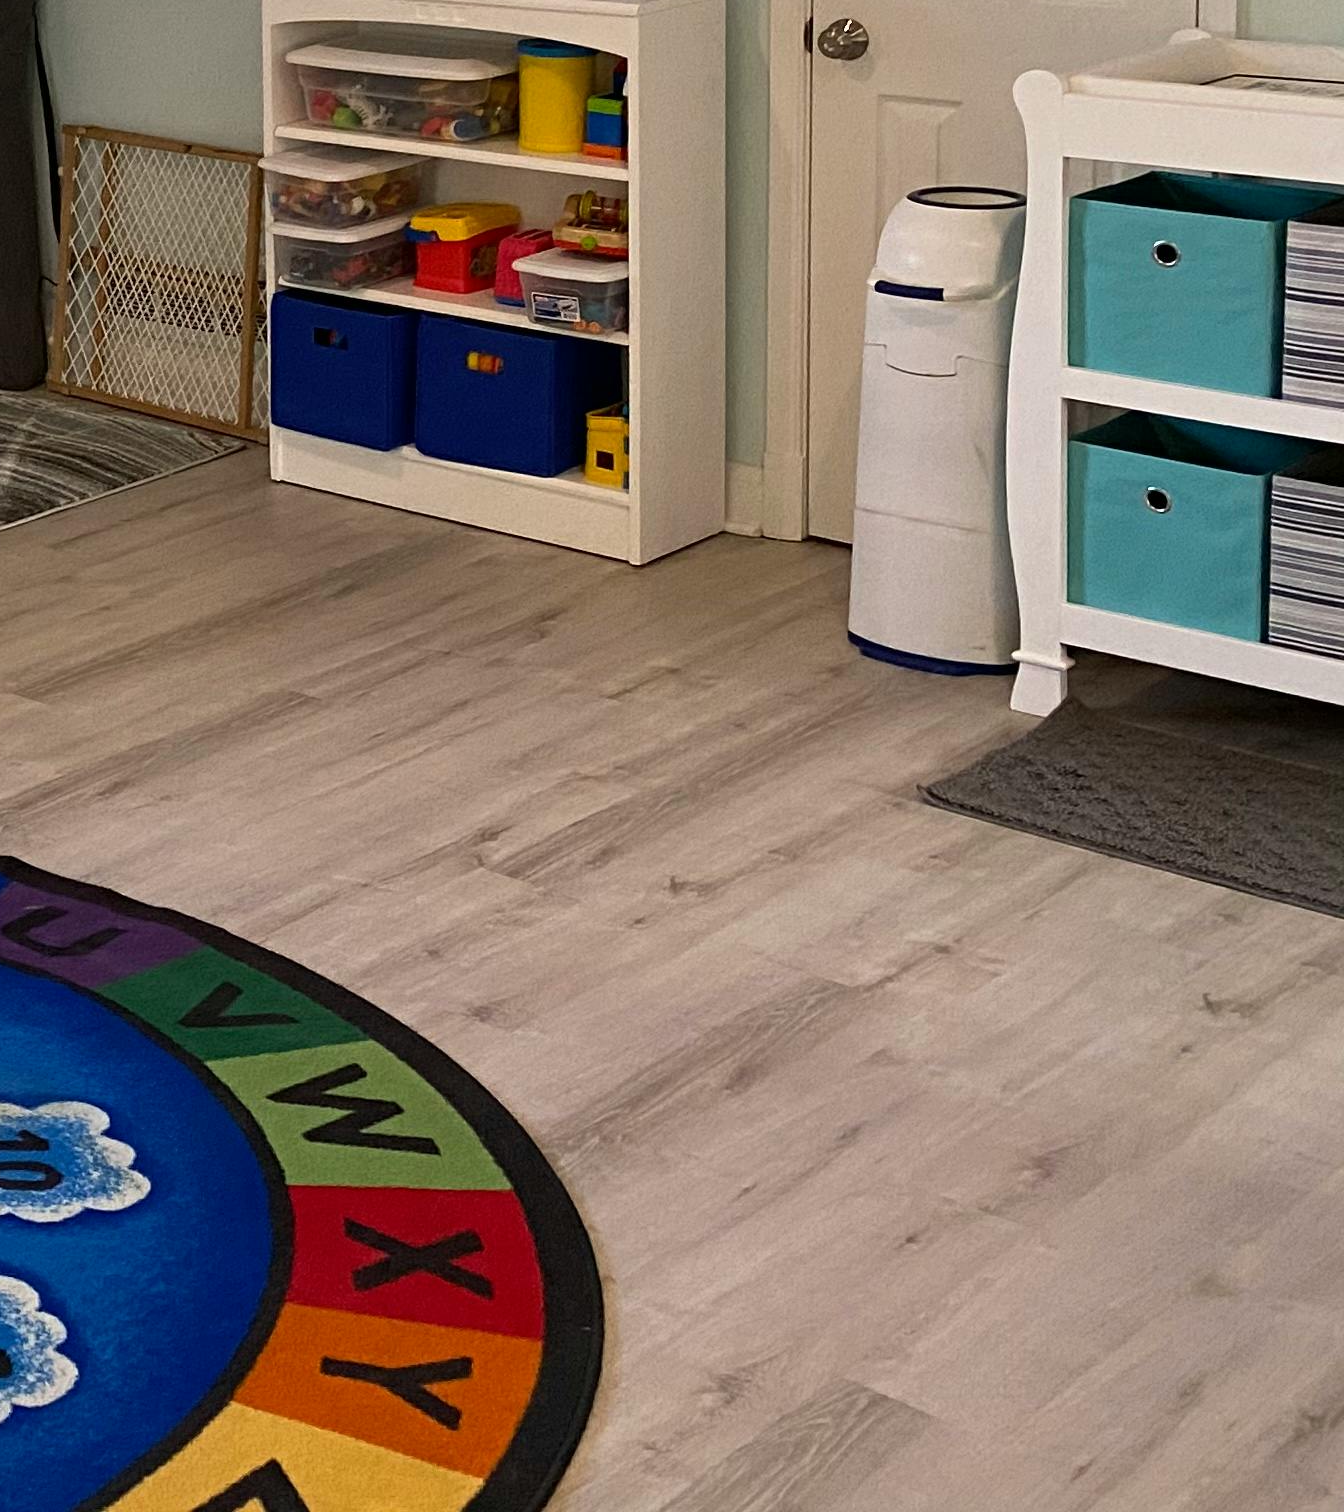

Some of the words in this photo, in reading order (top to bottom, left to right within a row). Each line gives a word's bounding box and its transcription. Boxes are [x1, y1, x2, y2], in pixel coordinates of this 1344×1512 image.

[0, 905, 127, 958] U
[177, 980, 302, 1028] V
[266, 1061, 443, 1158] W
[345, 1217, 495, 1300] X
[319, 1355, 475, 1431] Y
